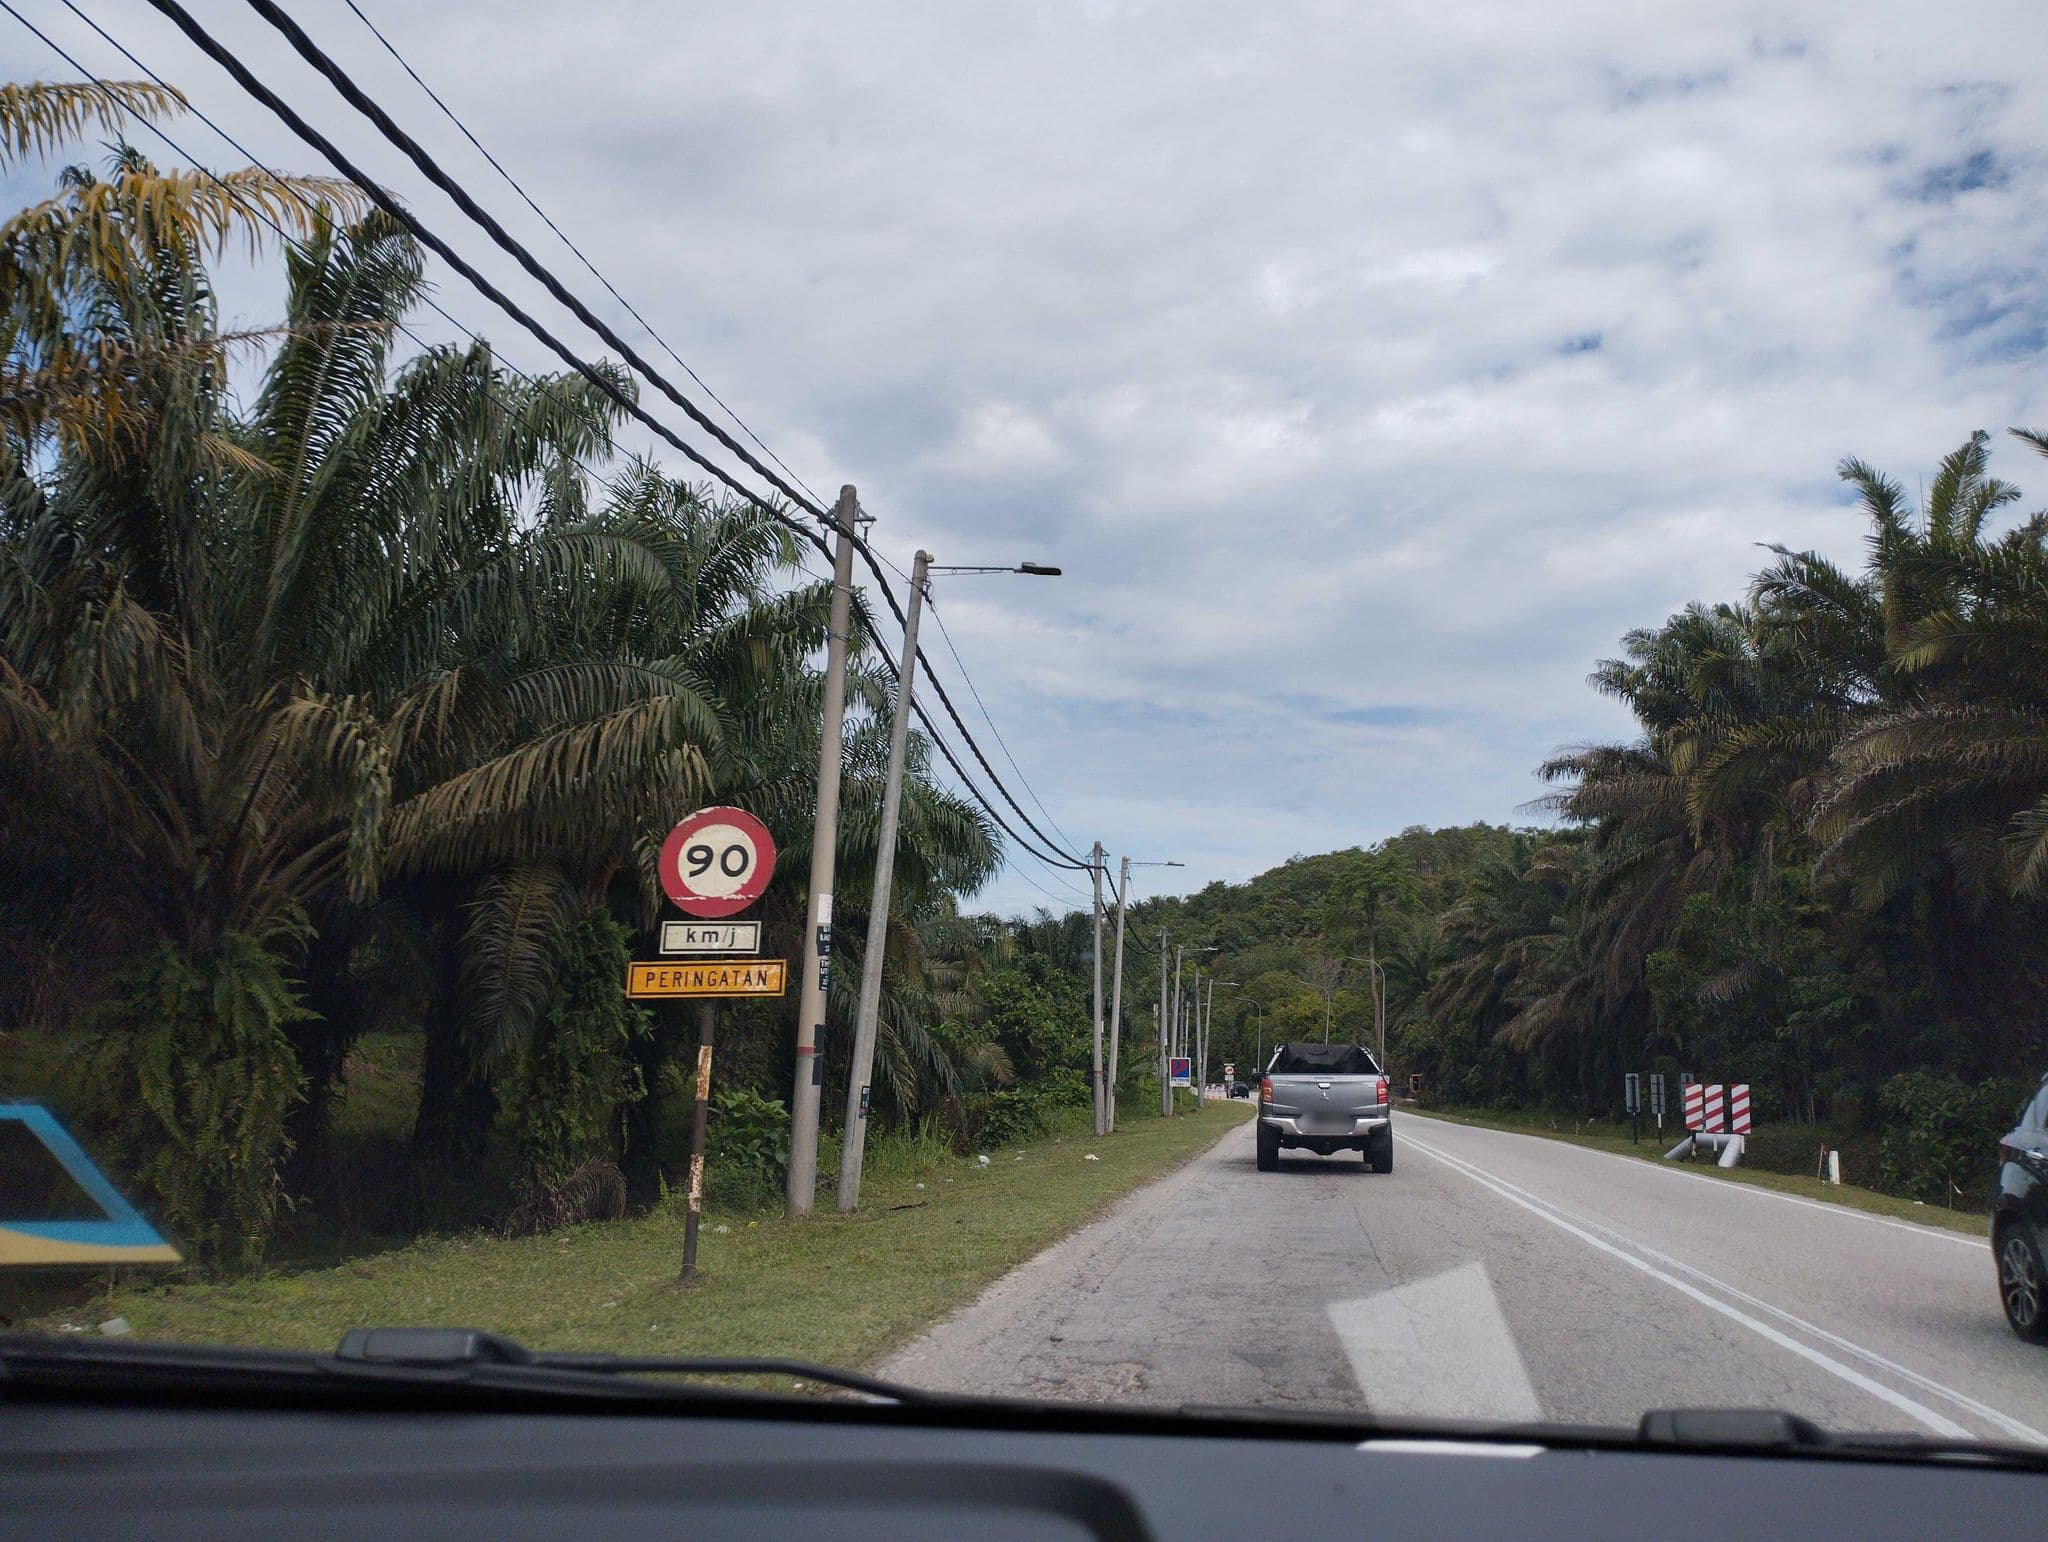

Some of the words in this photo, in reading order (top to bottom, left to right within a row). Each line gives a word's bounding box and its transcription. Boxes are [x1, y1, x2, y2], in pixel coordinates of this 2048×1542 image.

[686, 844, 749, 877] 90
[686, 927, 736, 948] km/j
[645, 970, 768, 988] PERINGATAN
